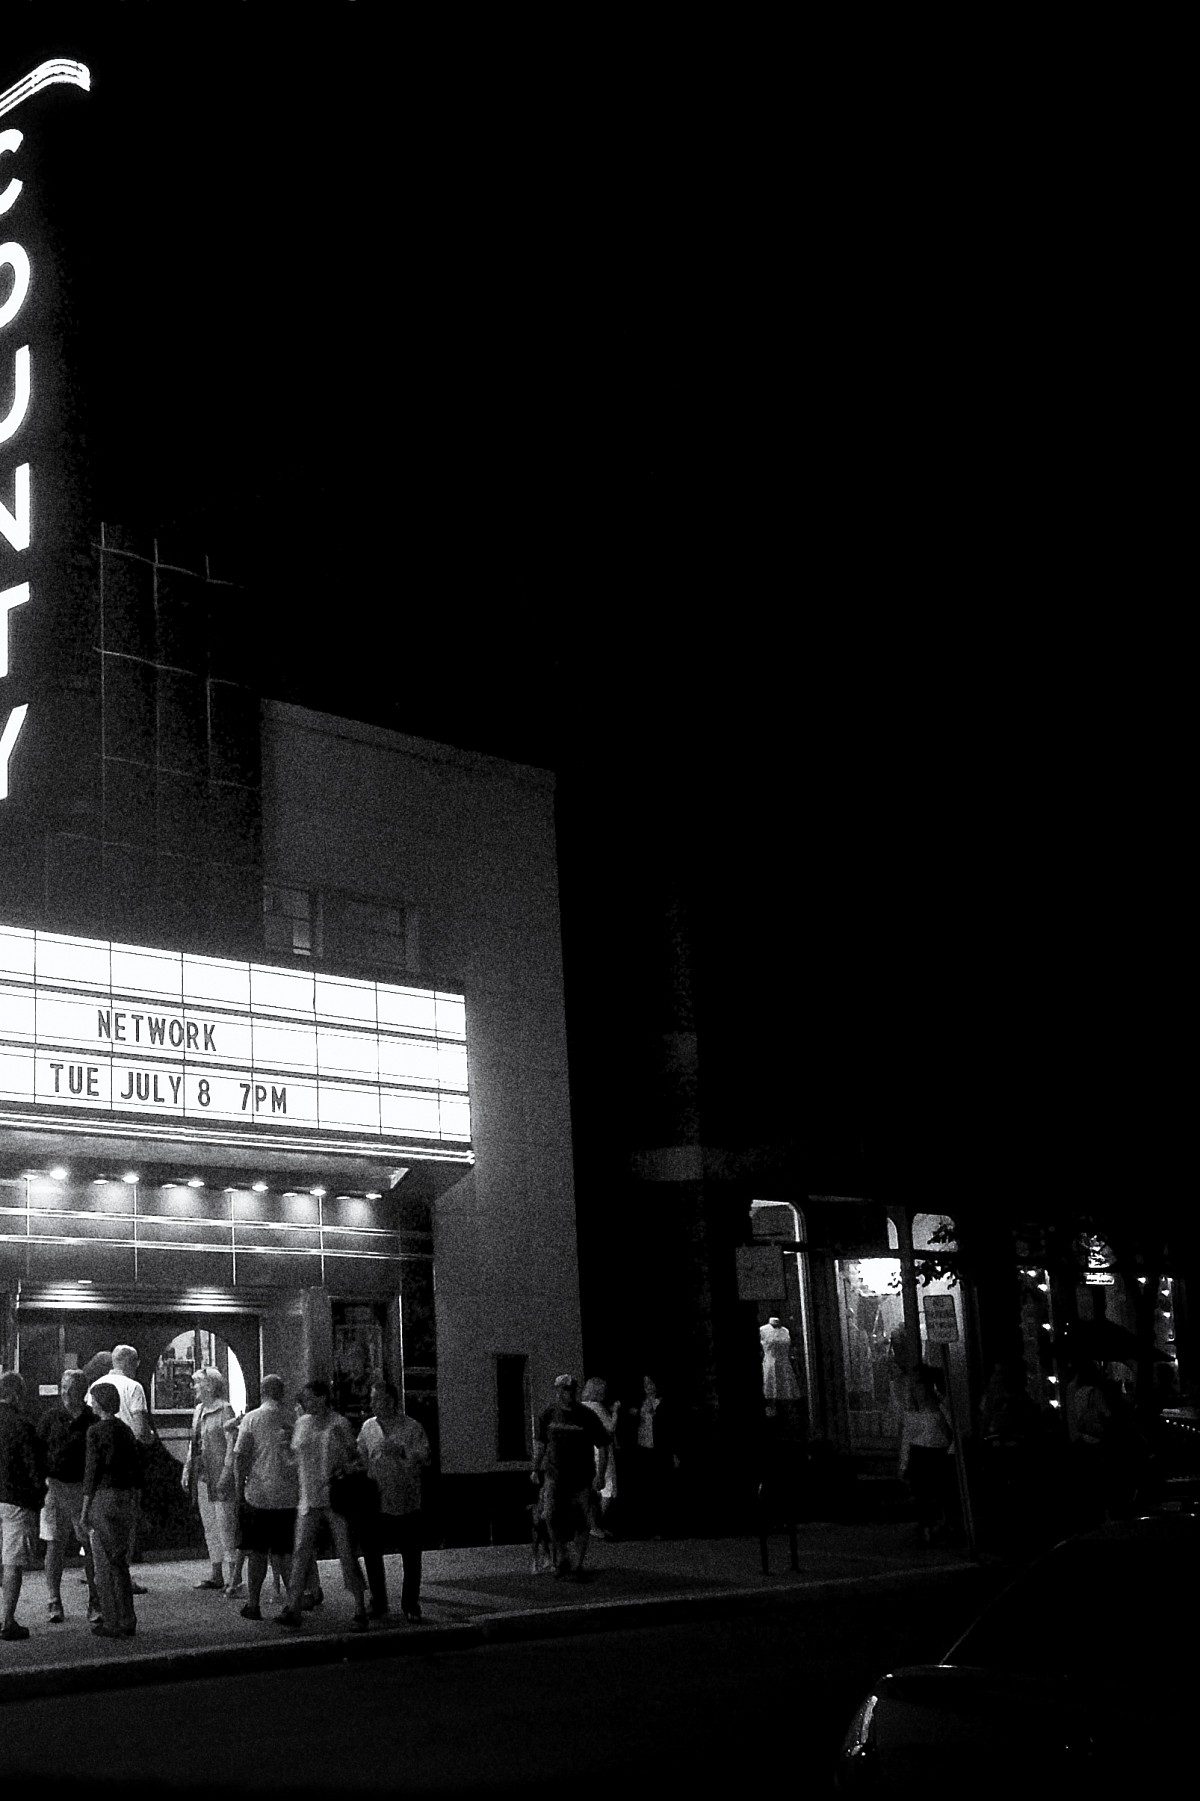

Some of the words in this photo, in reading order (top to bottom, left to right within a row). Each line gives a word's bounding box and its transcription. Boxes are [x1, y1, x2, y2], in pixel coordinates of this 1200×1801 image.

[97, 1010, 216, 1052] NETWORK
[49, 1062, 100, 1098] TUE
[119, 1070, 183, 1105] JULY
[197, 1078, 212, 1108] 8
[238, 1082, 288, 1115] 7PM
